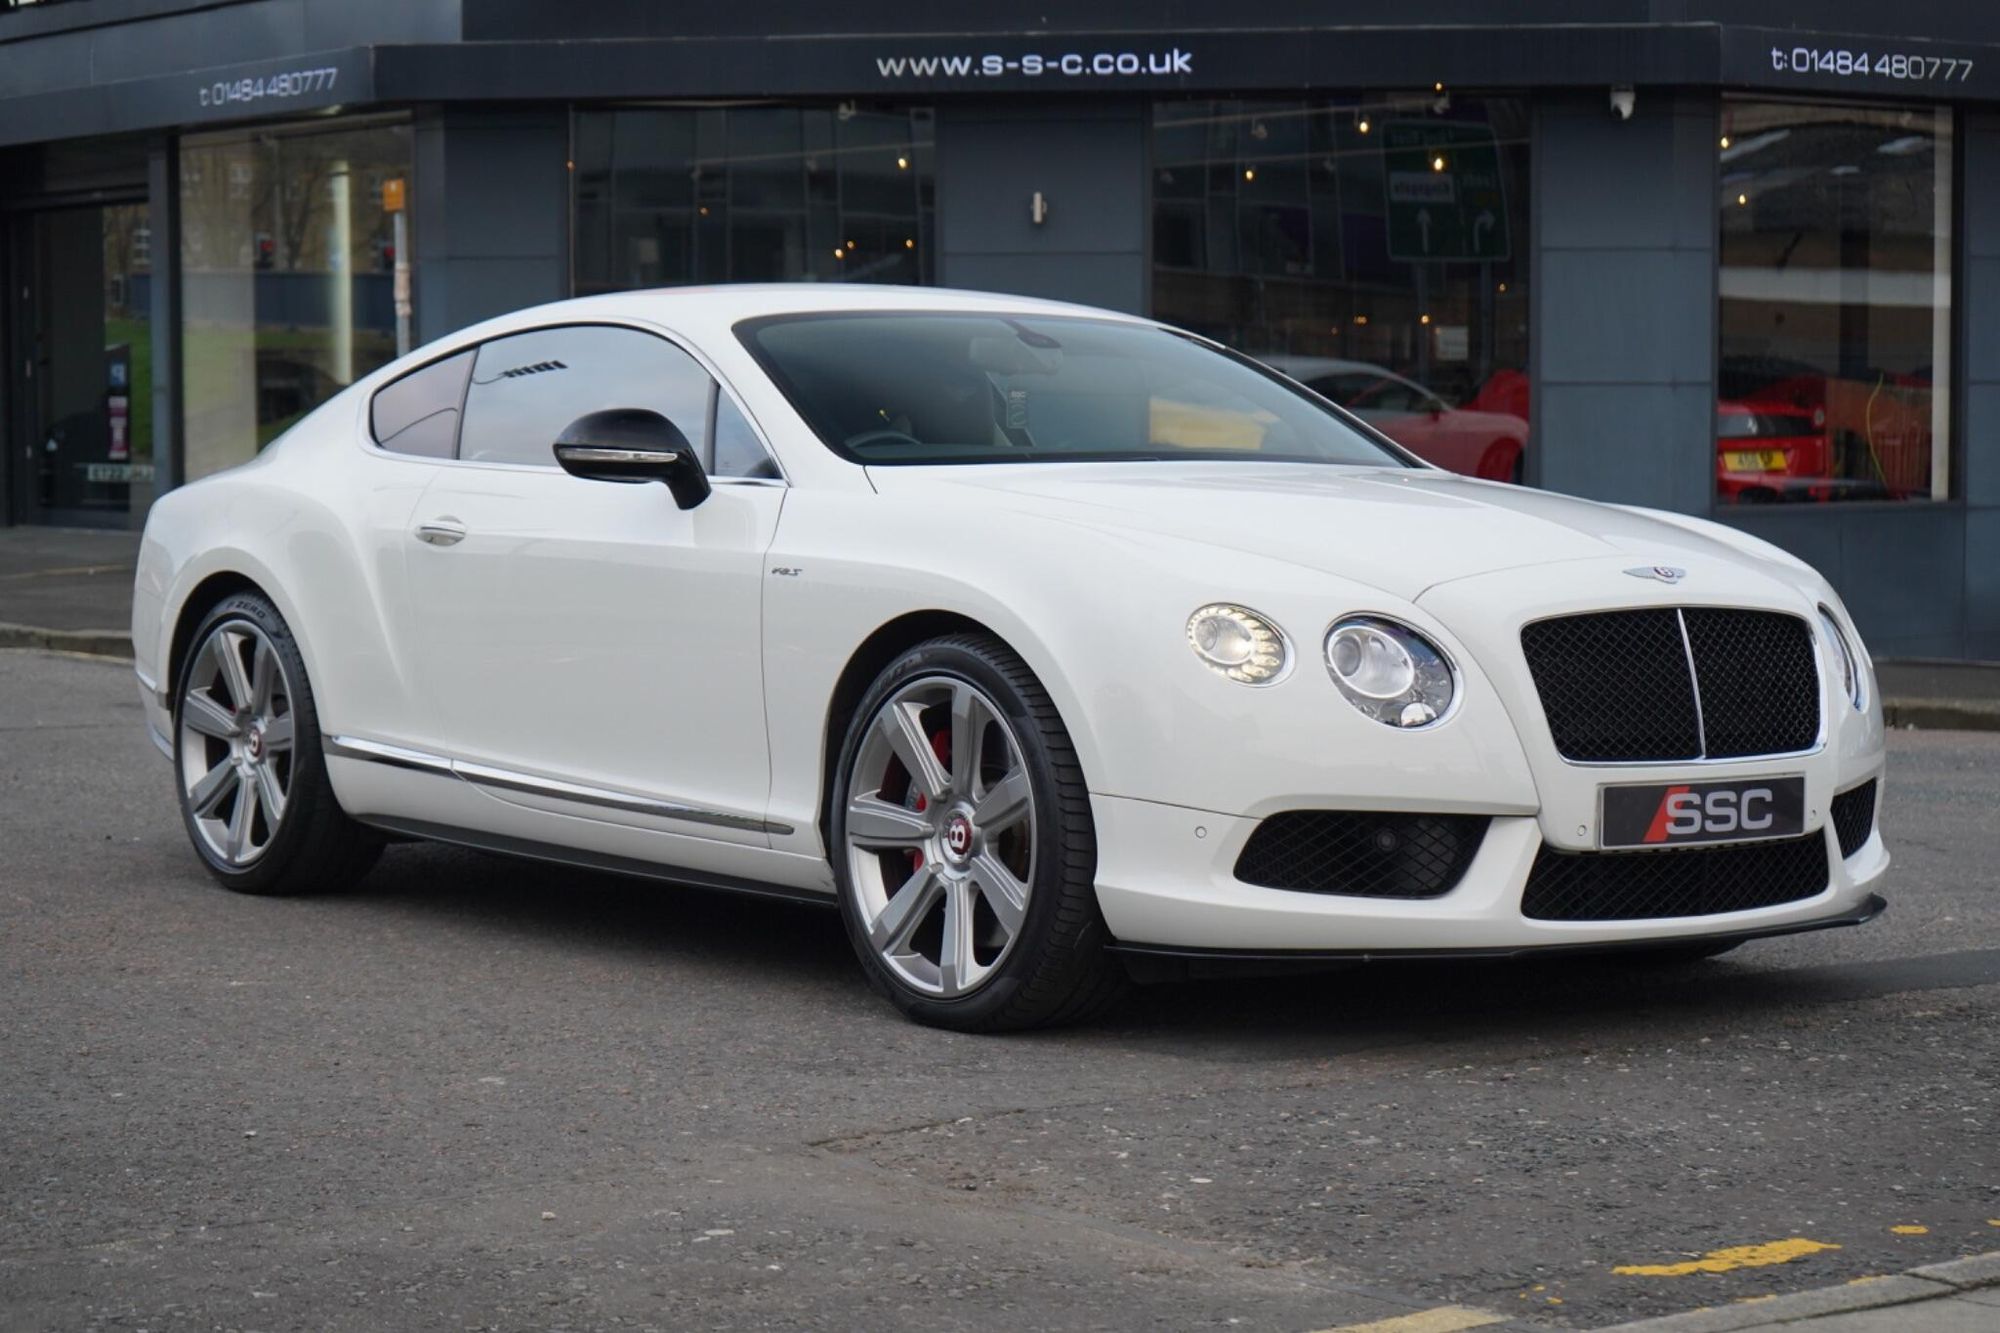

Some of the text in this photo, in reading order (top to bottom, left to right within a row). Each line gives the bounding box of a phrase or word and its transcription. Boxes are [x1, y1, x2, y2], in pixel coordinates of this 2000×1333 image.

[876, 49, 1192, 76] www.s-s-c.co.uk
[1792, 48, 1869, 75] 01484
[1874, 54, 1973, 81] 480777
[212, 78, 264, 105] 01484
[266, 67, 338, 97] 480777
[1665, 788, 1773, 835] SSC
